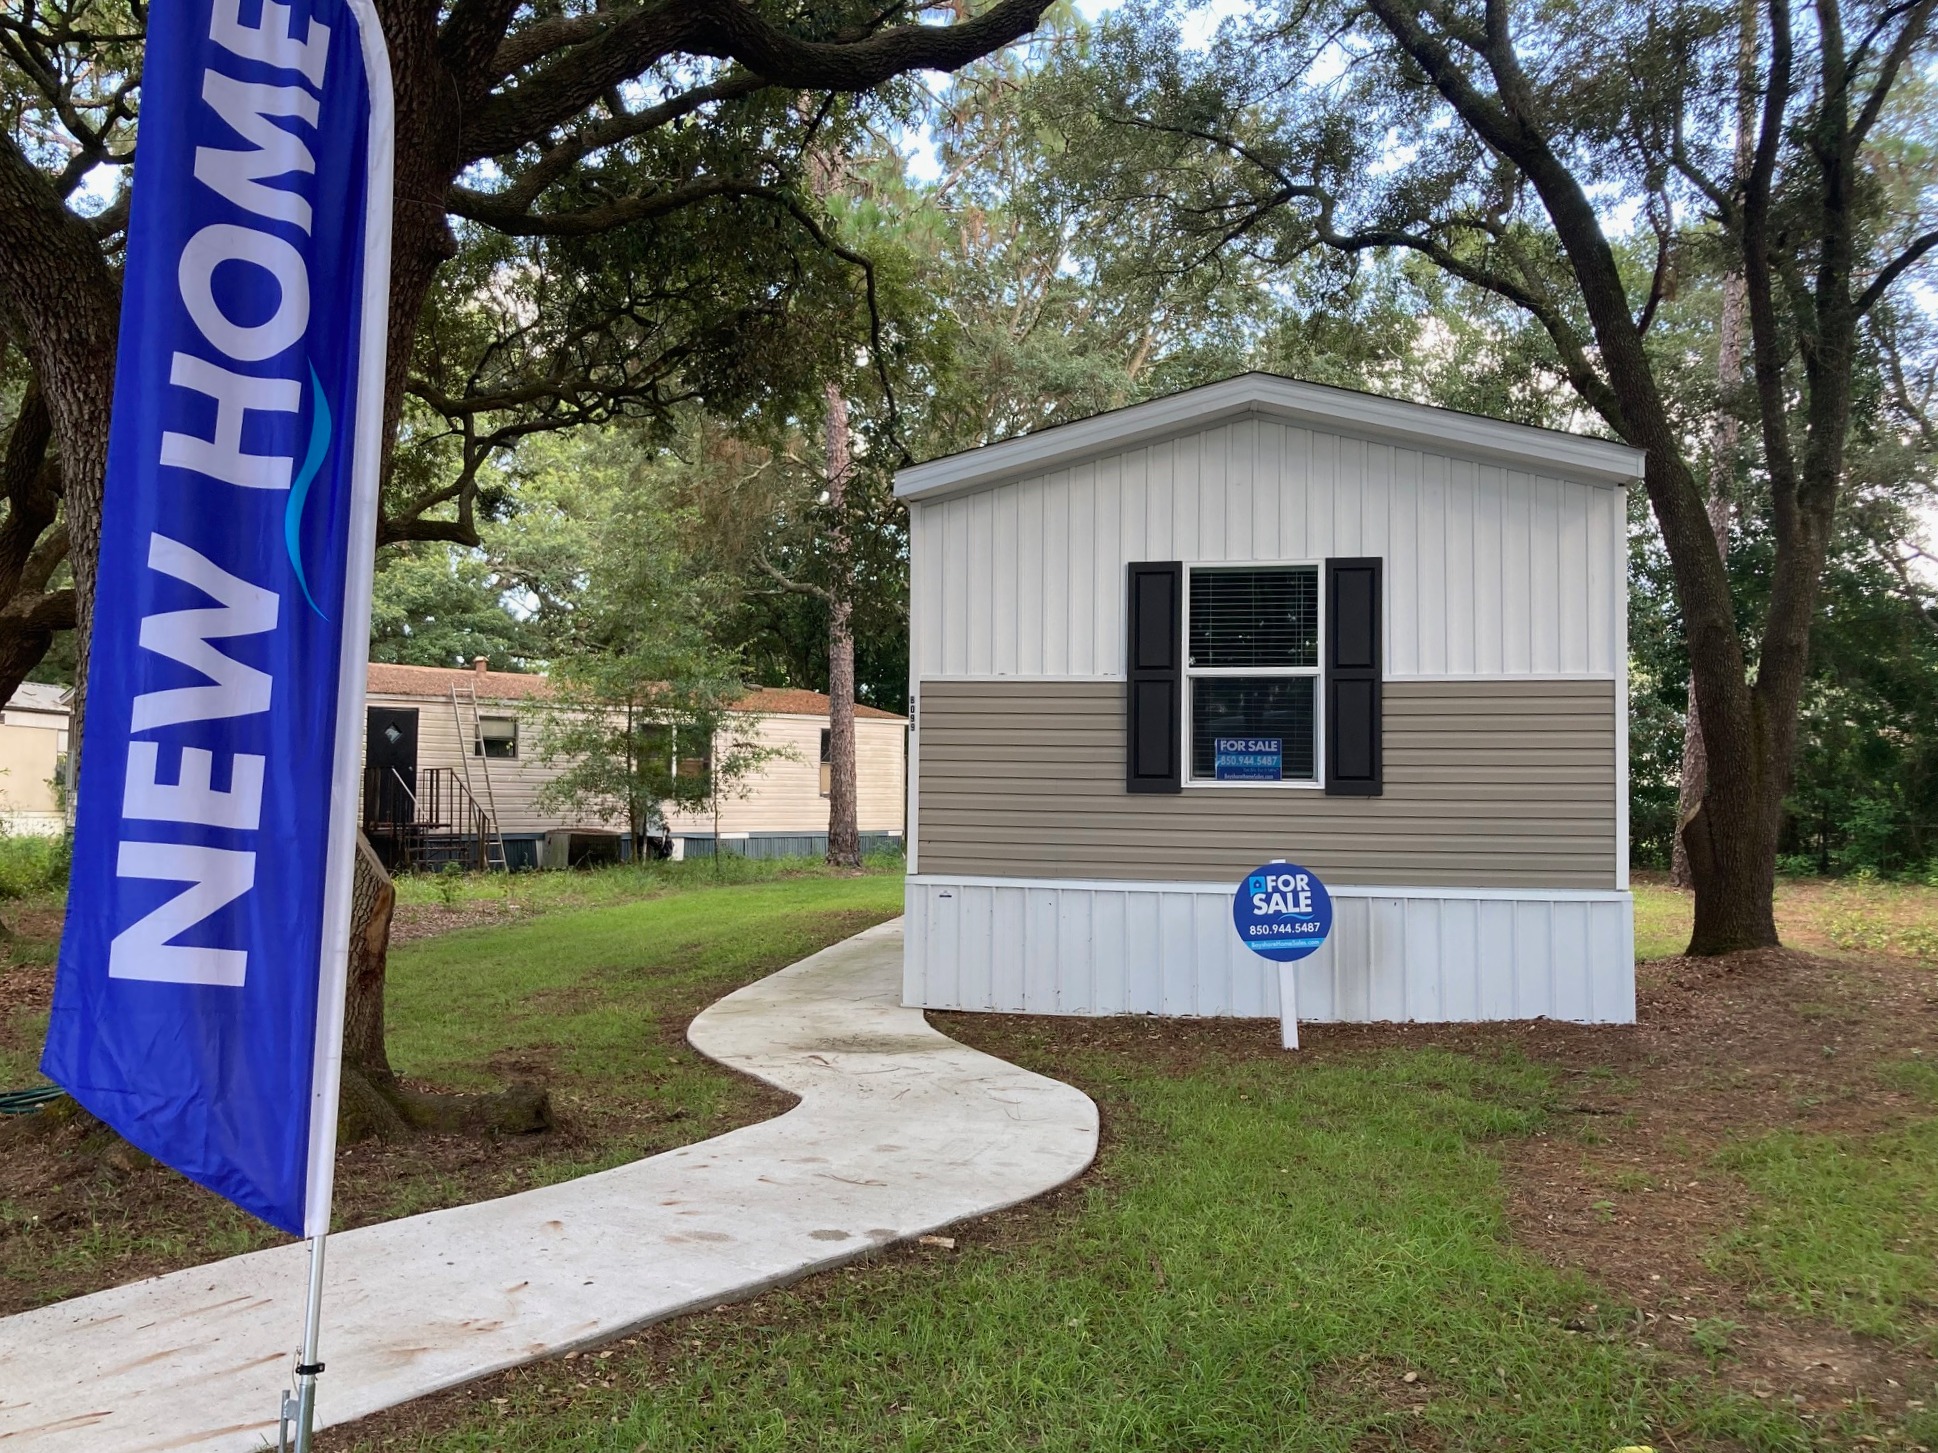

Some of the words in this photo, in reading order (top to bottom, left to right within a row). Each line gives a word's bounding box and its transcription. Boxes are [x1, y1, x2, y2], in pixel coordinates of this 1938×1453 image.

[160, 0, 331, 489] HOME
[1220, 740, 1246, 752] FOR
[1248, 740, 1278, 752] SALE
[109, 532, 280, 987] NEW
[1221, 756, 1278, 765] 850.944.5487
[1266, 874, 1311, 893] FOR
[1253, 891, 1313, 916] SALE
[1249, 922, 1321, 935] 850.944.5487
